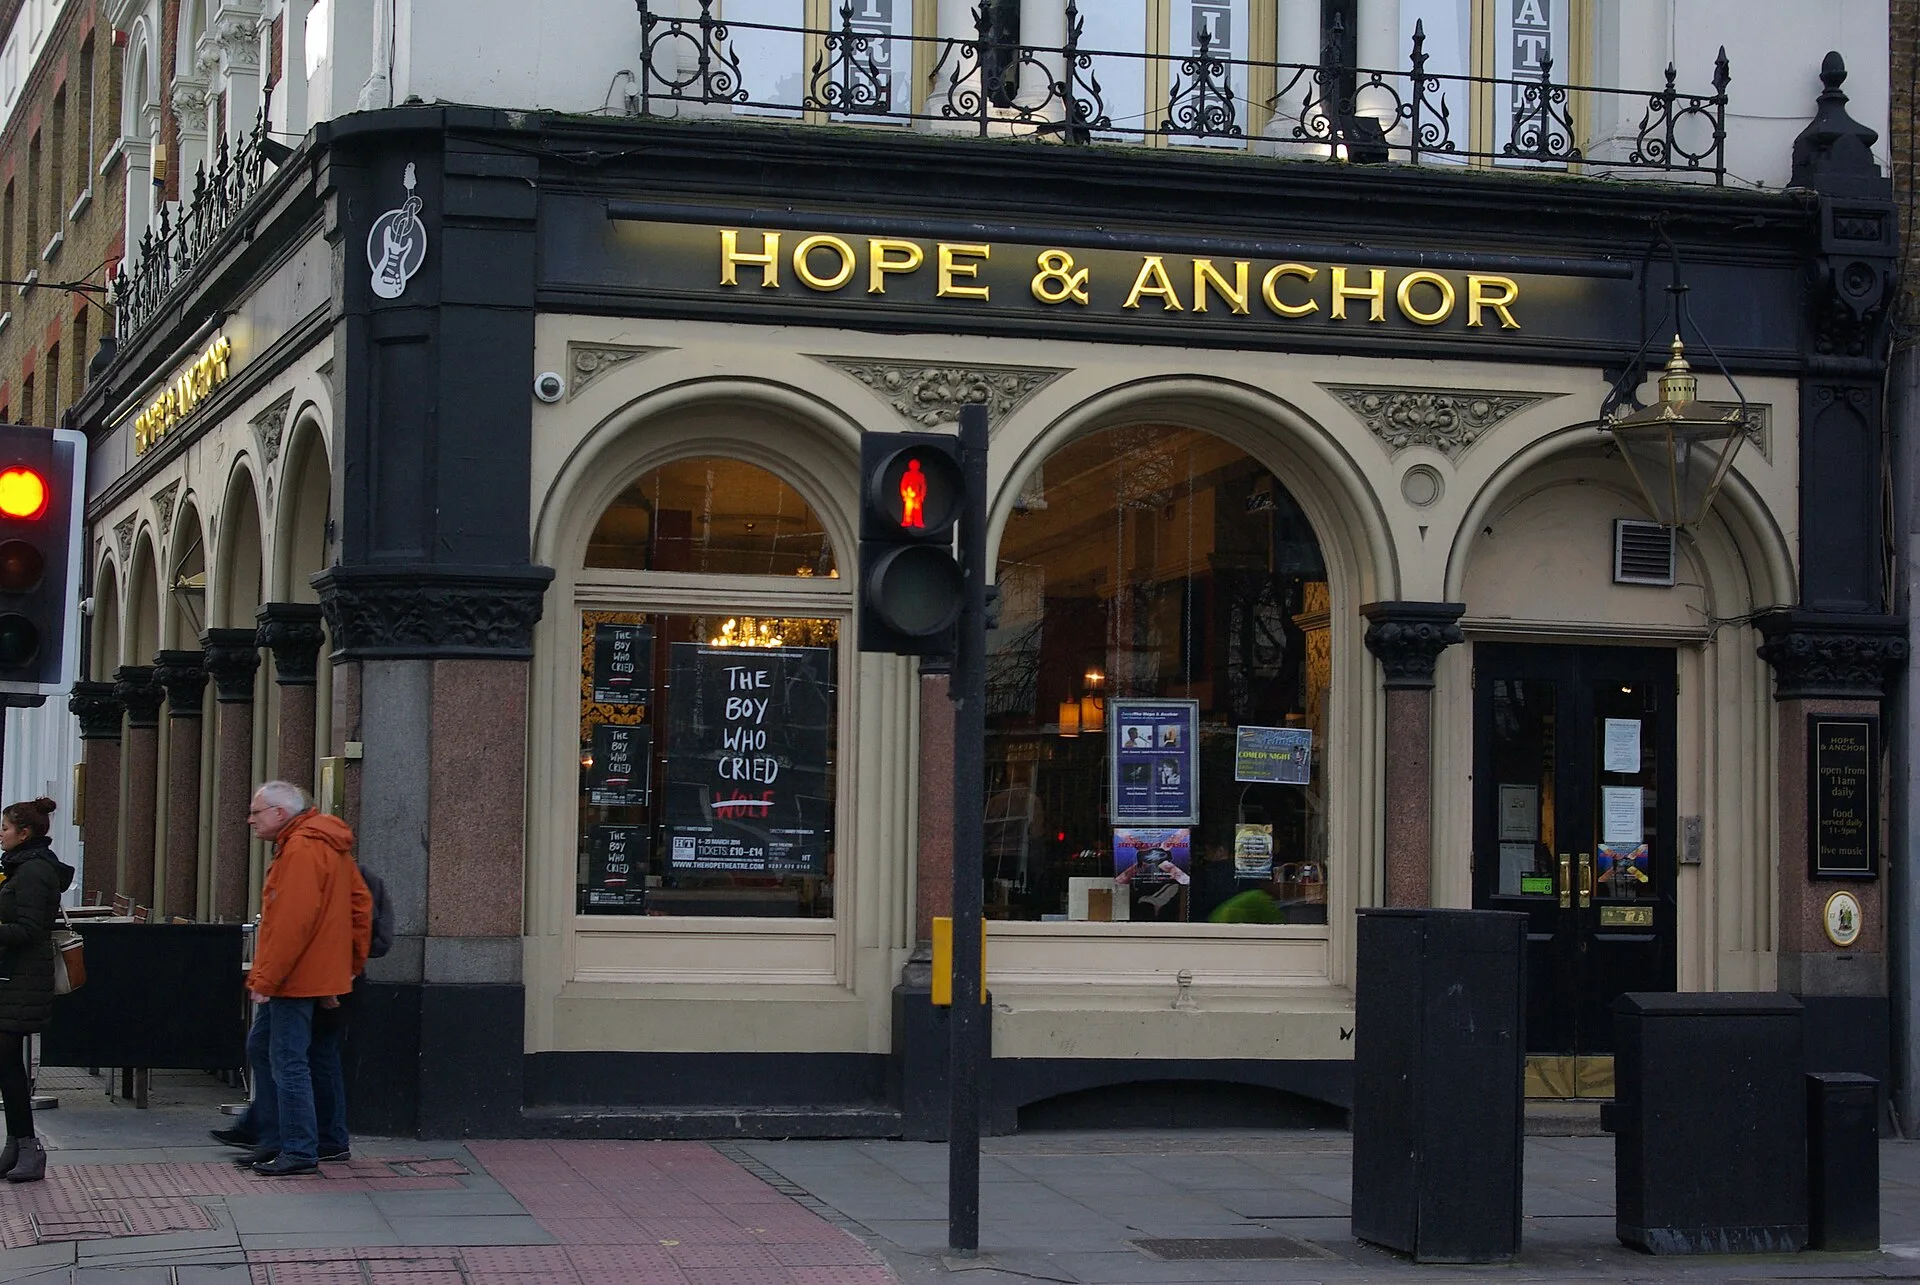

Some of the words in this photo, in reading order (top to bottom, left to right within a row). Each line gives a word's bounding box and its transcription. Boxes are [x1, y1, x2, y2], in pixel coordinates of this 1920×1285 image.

[719, 229, 990, 302] HOPE
[1030, 249, 1089, 305] &
[1122, 256, 1521, 329] ANCHOR
[613, 630, 632, 640] THE
[614, 640, 631, 652] BOY
[613, 651, 630, 661] WHO
[611, 661, 634, 673] CRIED
[722, 666, 771, 691] THE
[725, 697, 768, 724] BOY
[611, 730, 629, 740] THE
[723, 726, 766, 752] WHO
[611, 741, 628, 752] BOY
[1830, 737, 1856, 745] HOPE
[1829, 744, 1866, 752] ANCHOR
[610, 752, 627, 762] WHO
[1238, 751, 1268, 760] COMEDY
[1269, 752, 1291, 761] NIGHT
[608, 762, 632, 774] CRIED
[718, 756, 778, 784] CRIED
[1820, 766, 1842, 776] open
[1844, 765, 1866, 775] from
[1831, 786, 1855, 799] daily
[714, 789, 775, 820] WOLF
[1832, 808, 1853, 818] food
[609, 830, 626, 840] THE
[609, 841, 626, 852] BOY
[608, 852, 625, 862] WHO
[606, 862, 629, 874] CRIED
